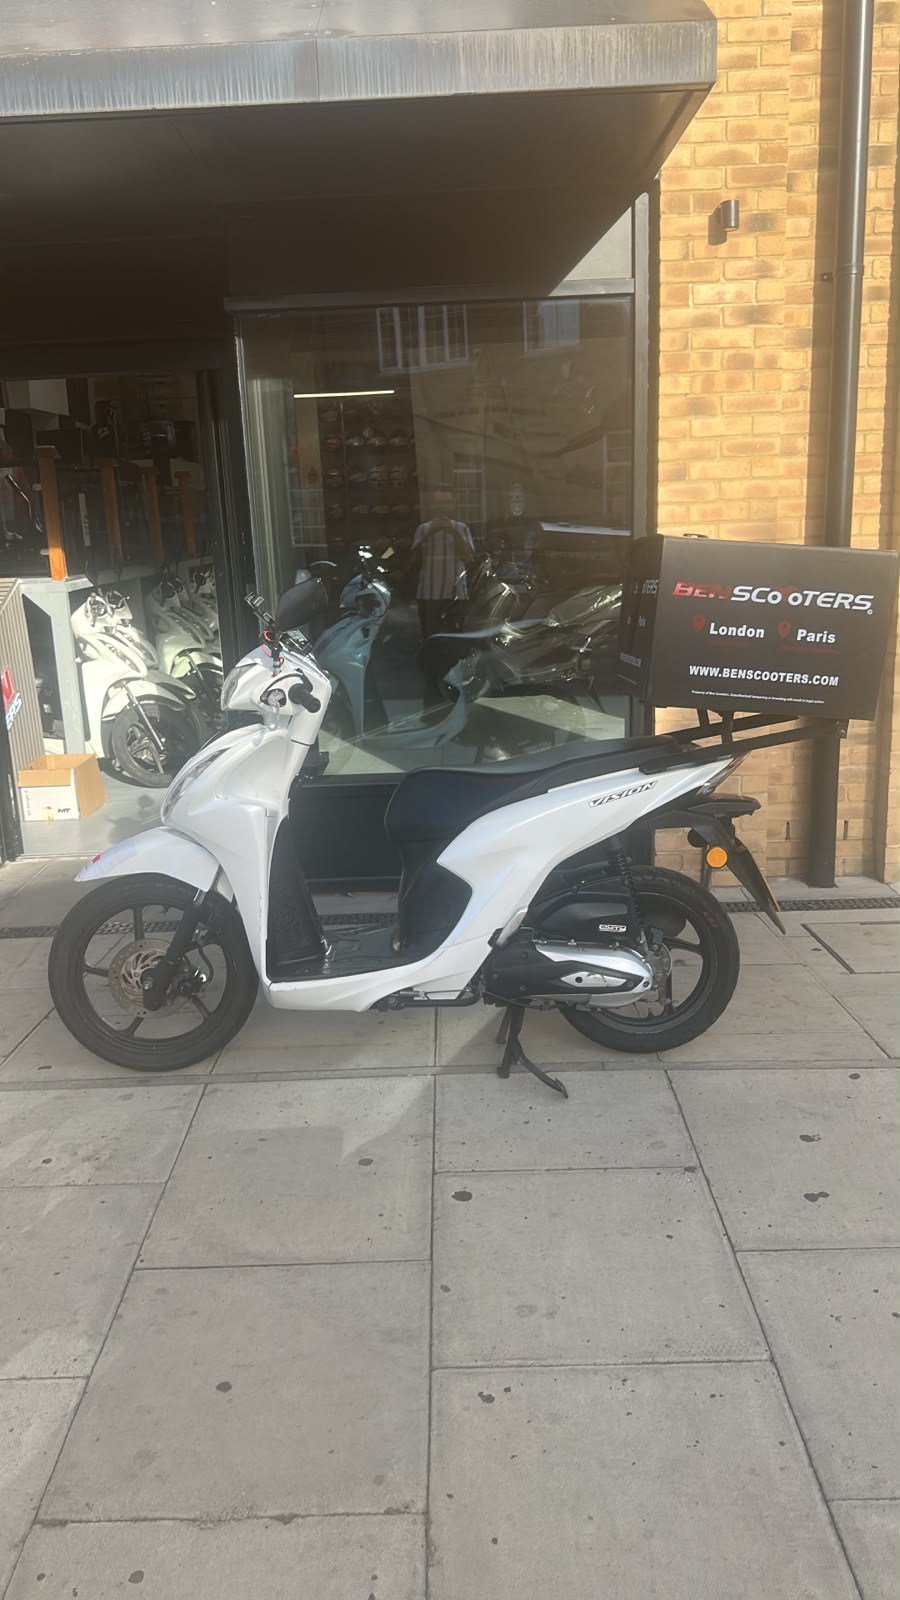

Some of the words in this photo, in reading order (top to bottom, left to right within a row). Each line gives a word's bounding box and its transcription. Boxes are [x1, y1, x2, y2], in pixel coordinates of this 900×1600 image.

[709, 623, 765, 638] London
[797, 629, 836, 643] Paris
[689, 665, 839, 687] WWW.BENSCOOTERS.COM
[588, 781, 657, 808] VISION
